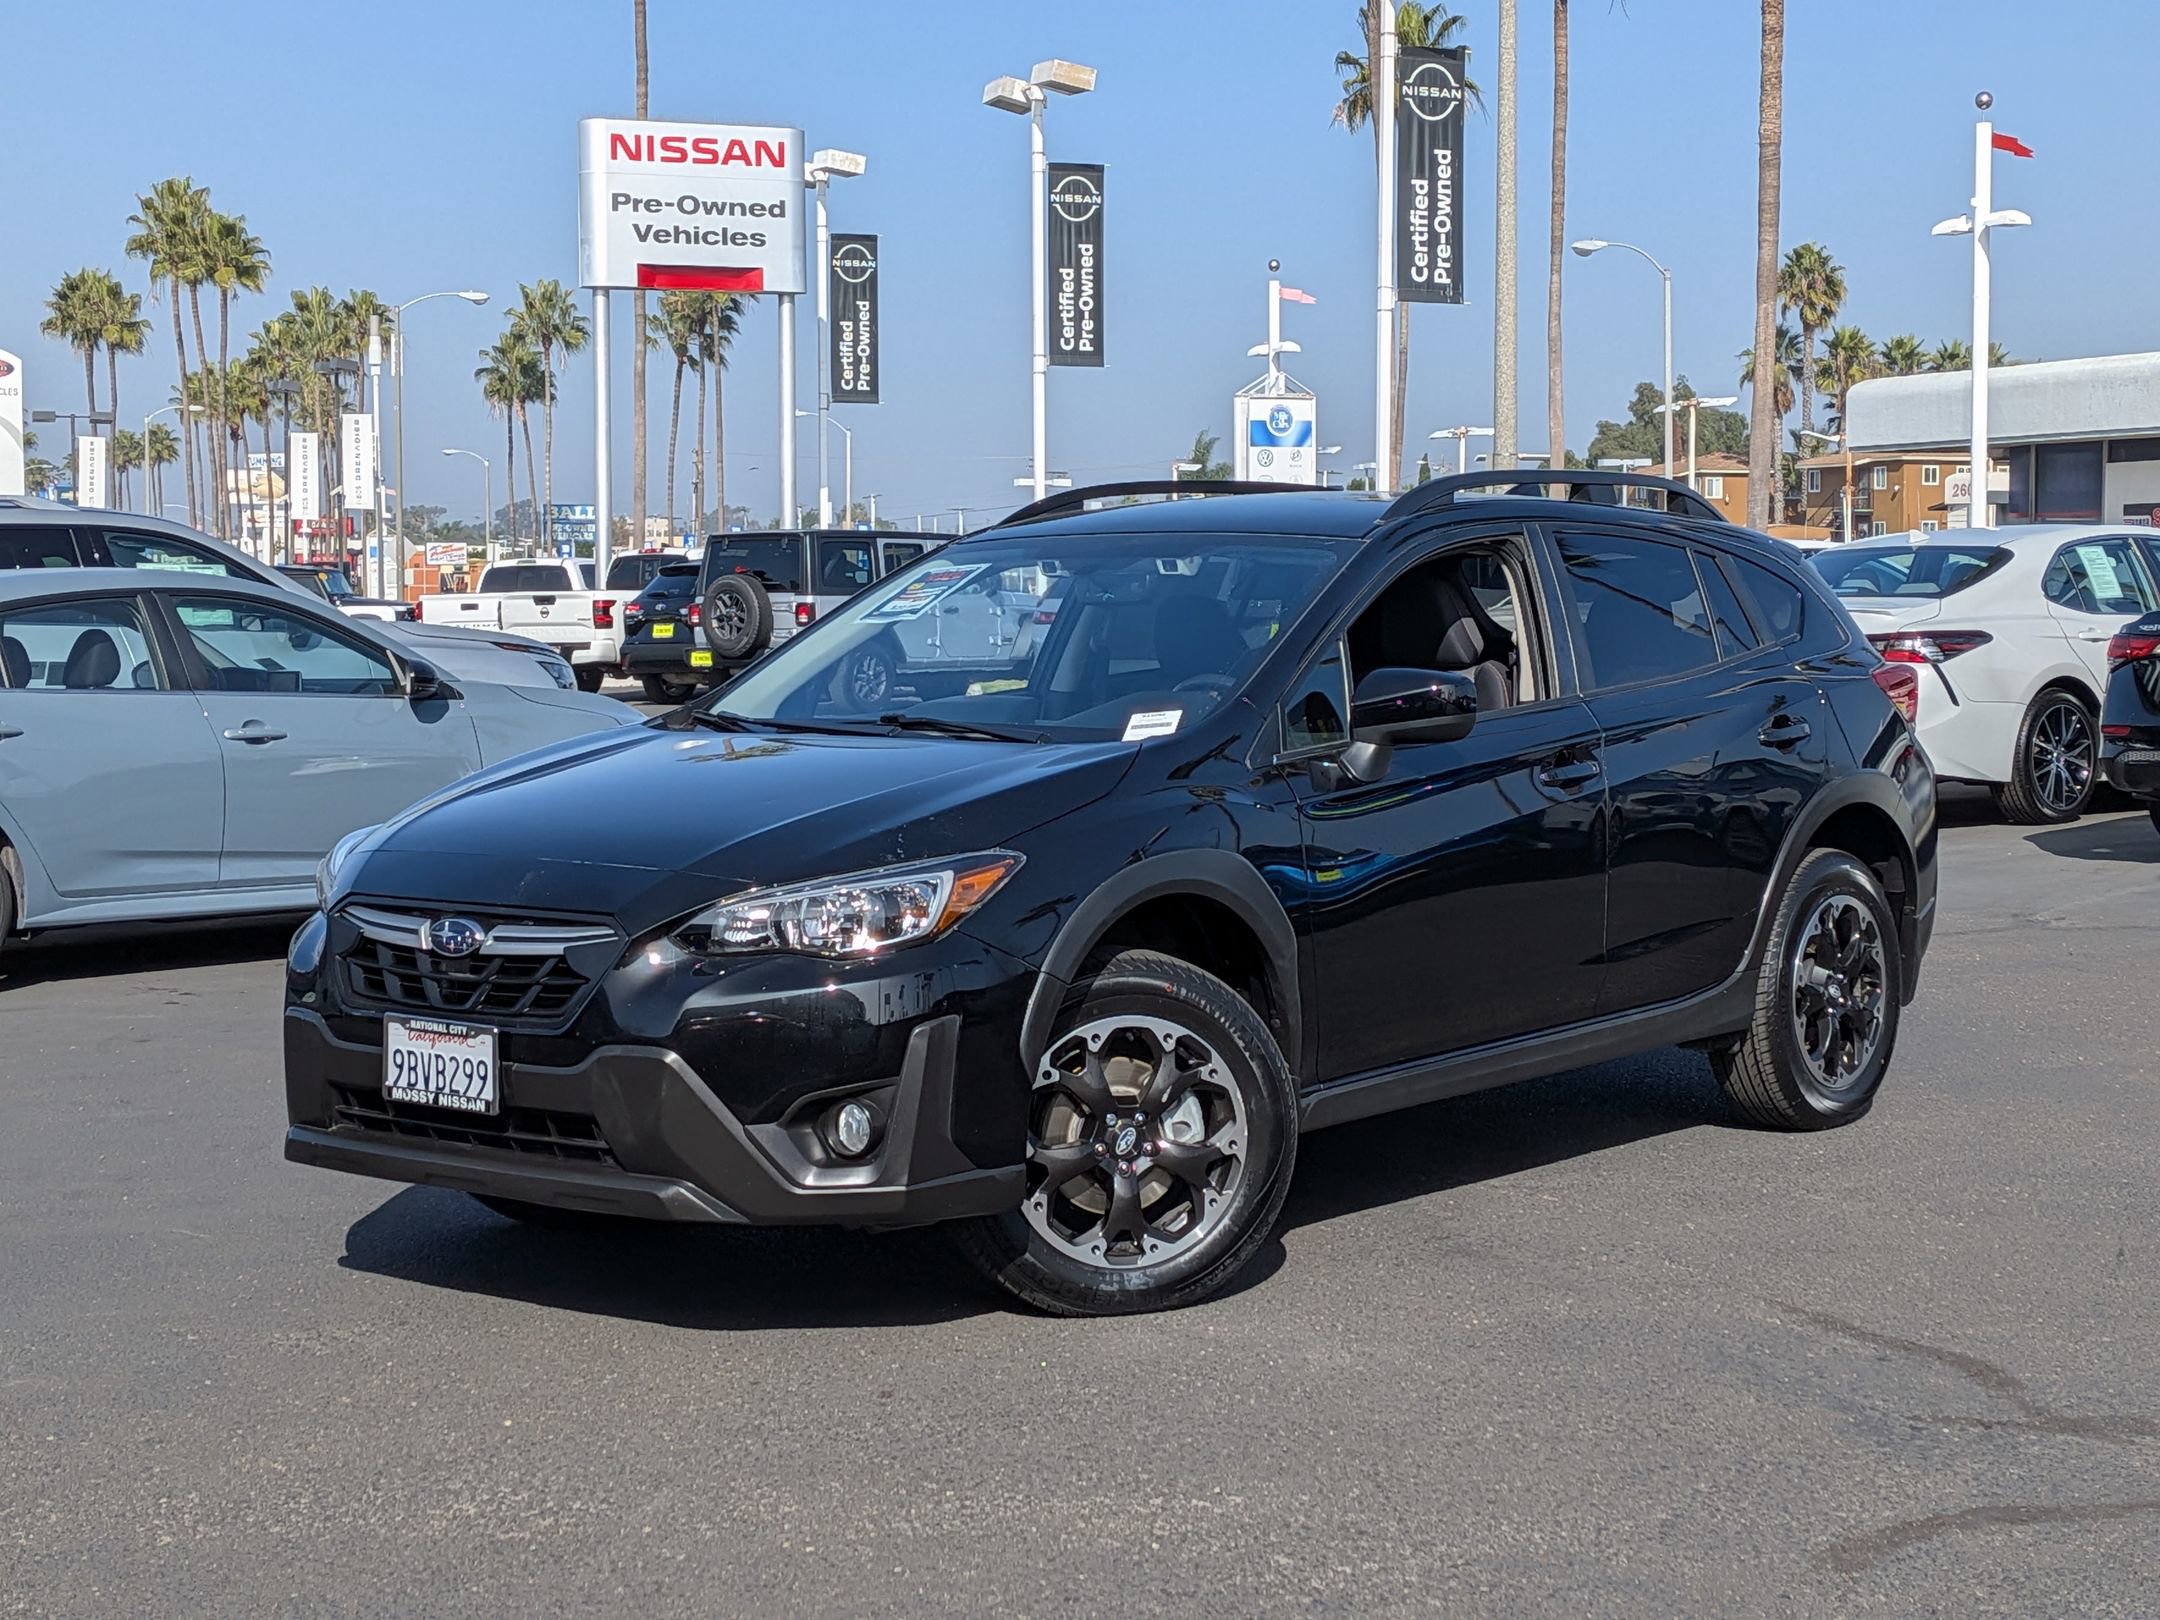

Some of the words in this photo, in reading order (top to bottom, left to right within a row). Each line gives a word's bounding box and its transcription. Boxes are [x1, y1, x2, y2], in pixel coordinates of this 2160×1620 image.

[1402, 85, 1462, 99] NISSAN
[610, 133, 785, 168] NISSAN
[611, 192, 786, 218] Pre-Owned
[1050, 193, 1102, 204] NISSAN
[1410, 179, 1429, 282] Certified
[1433, 149, 1452, 284] Pre-Owned
[632, 223, 767, 247] Vehicles
[832, 258, 876, 268] NISSAN
[1059, 268, 1075, 350] Certified
[1078, 243, 1094, 351] Pre-Owned
[840, 321, 854, 390] Certified
[856, 300, 871, 391] Pre-Owned
[410, 1020, 447, 1033] NATIONAL
[449, 1025, 467, 1035] CITY
[393, 1048, 488, 1098] 9BVB299
[392, 1087, 435, 1104] MOSSY
[439, 1094, 486, 1112] NISSAN
